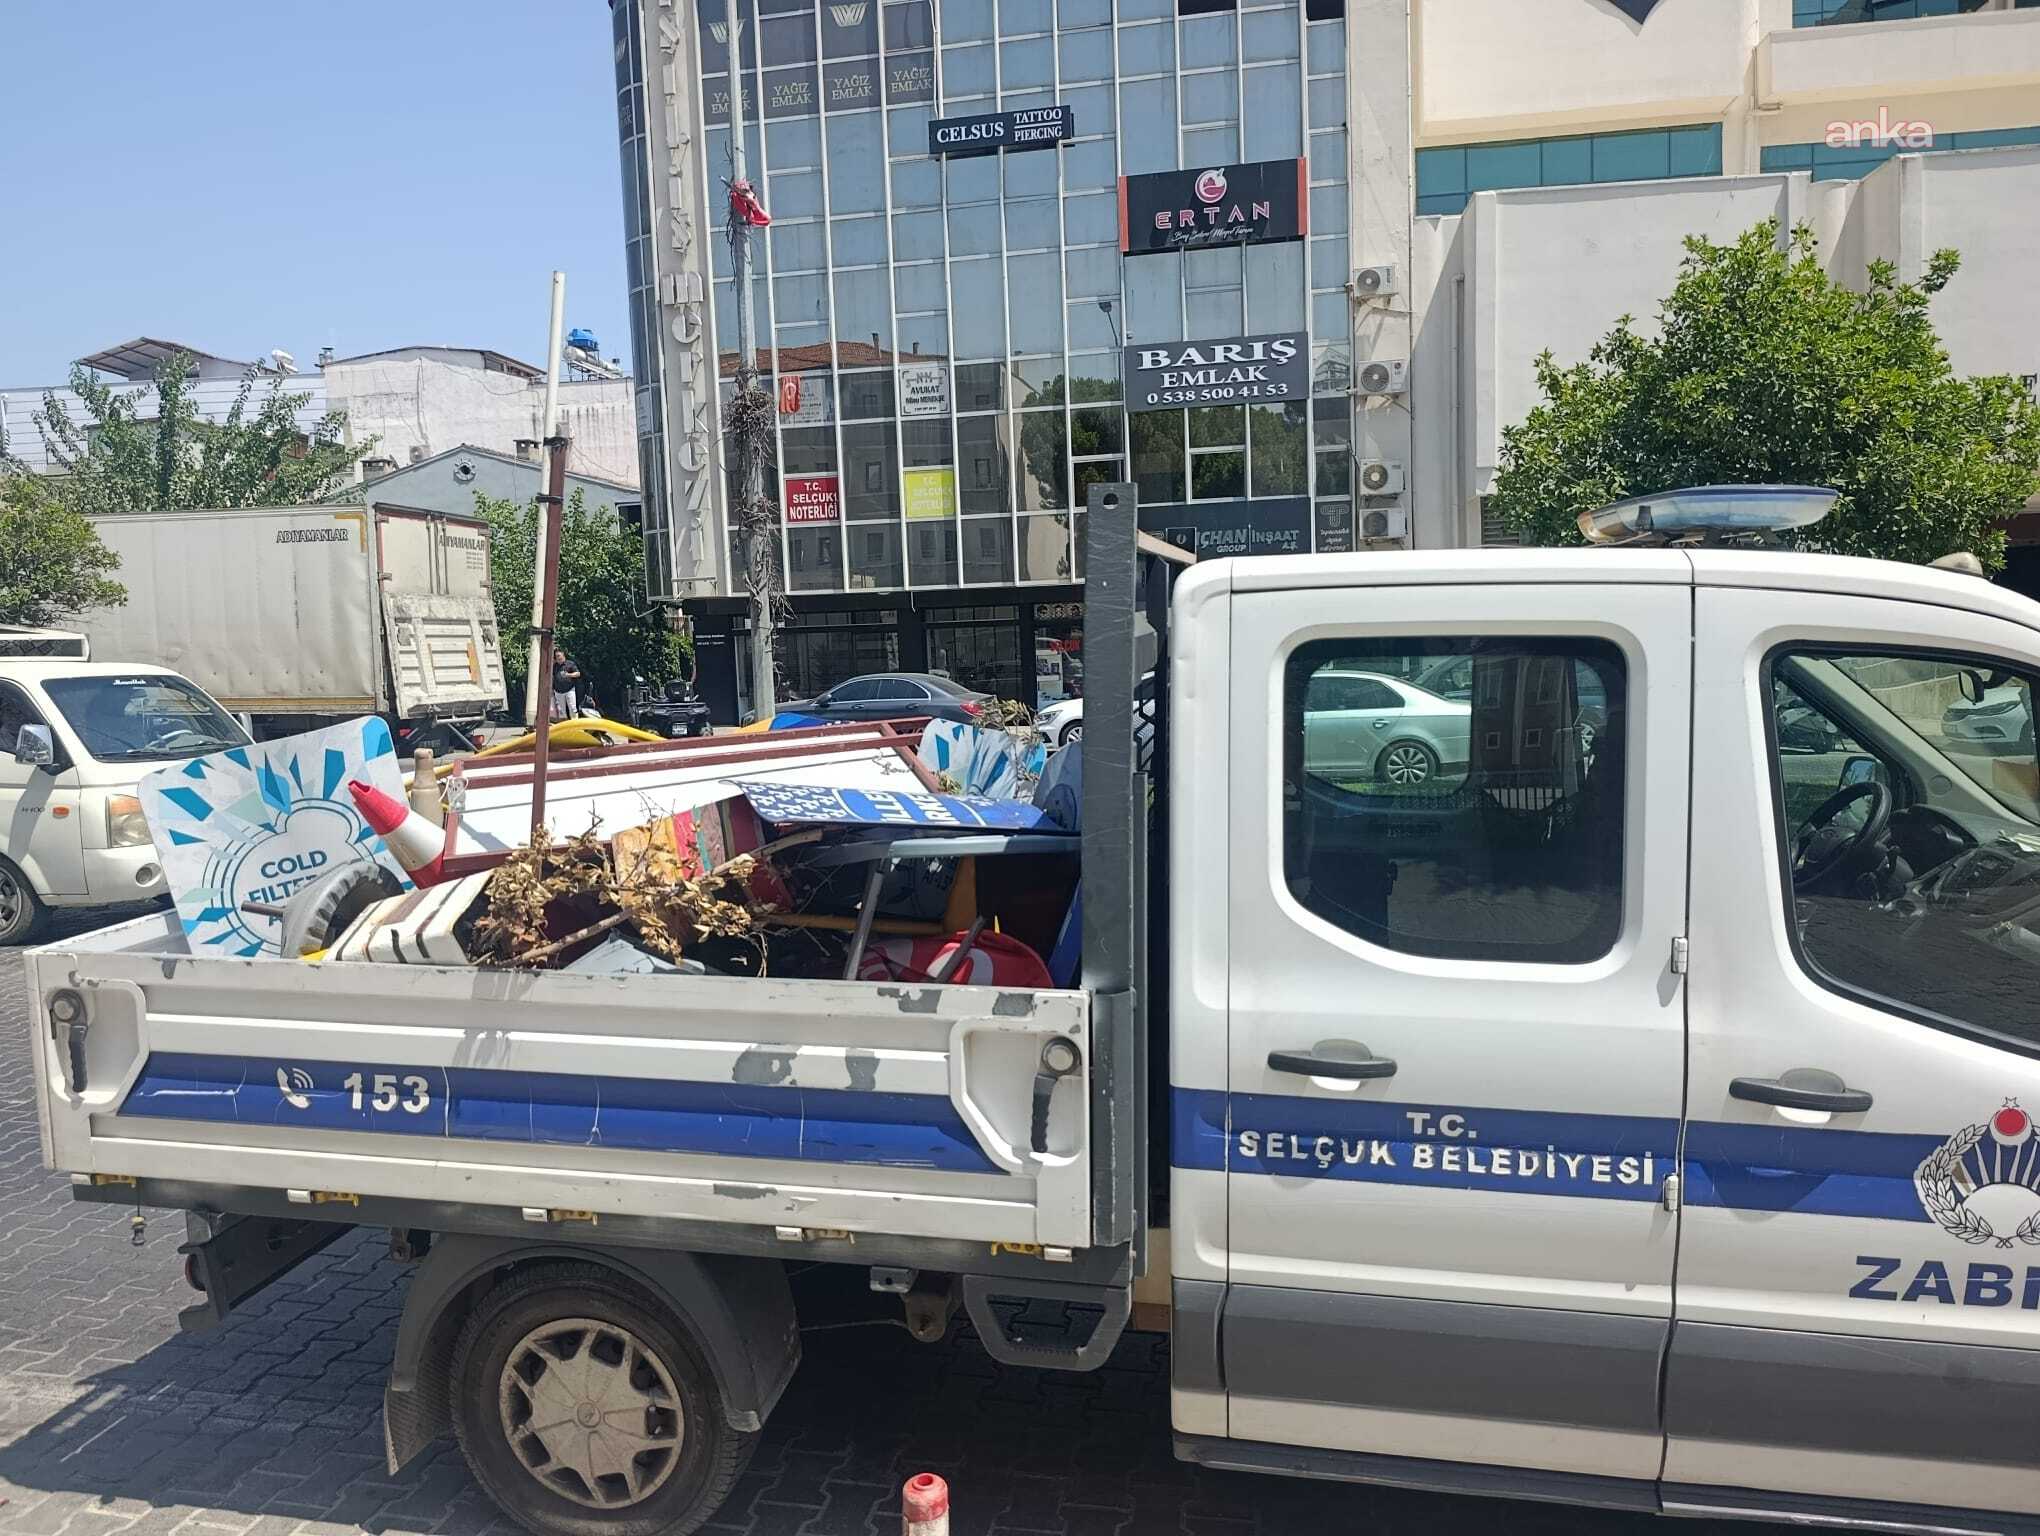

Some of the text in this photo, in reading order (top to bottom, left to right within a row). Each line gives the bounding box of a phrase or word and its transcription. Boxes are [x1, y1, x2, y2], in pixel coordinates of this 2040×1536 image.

[773, 82, 810, 97] YAĞIZ
[833, 74, 871, 89] YAĞIZ
[891, 78, 933, 94] EMLAK
[712, 88, 749, 103] YAZ
[771, 93, 812, 108] EMLAK
[831, 86, 873, 101] EMLAK
[711, 100, 752, 114] EMK
[1013, 108, 1063, 124] TATTOO
[936, 121, 1005, 143] CELSUS
[1014, 126, 1063, 142] PIERCING
[1155, 201, 1270, 229] ERTAN
[1136, 338, 1297, 370] BARIŞ
[1160, 365, 1270, 388] EMLAK
[911, 385, 940, 395] AVUKAT
[1147, 383, 1289, 404] 0 538 500 41 53
[804, 482, 822, 491] T.C.
[276, 528, 349, 544] ADIYAMANLAR
[1216, 544, 1247, 553] GROUP
[261, 850, 328, 879] COLD
[344, 1072, 431, 1114] 153
[1406, 1111, 1477, 1138] T.C.
[1239, 1130, 1654, 1186] SELÇUK BELEDİYESİ
